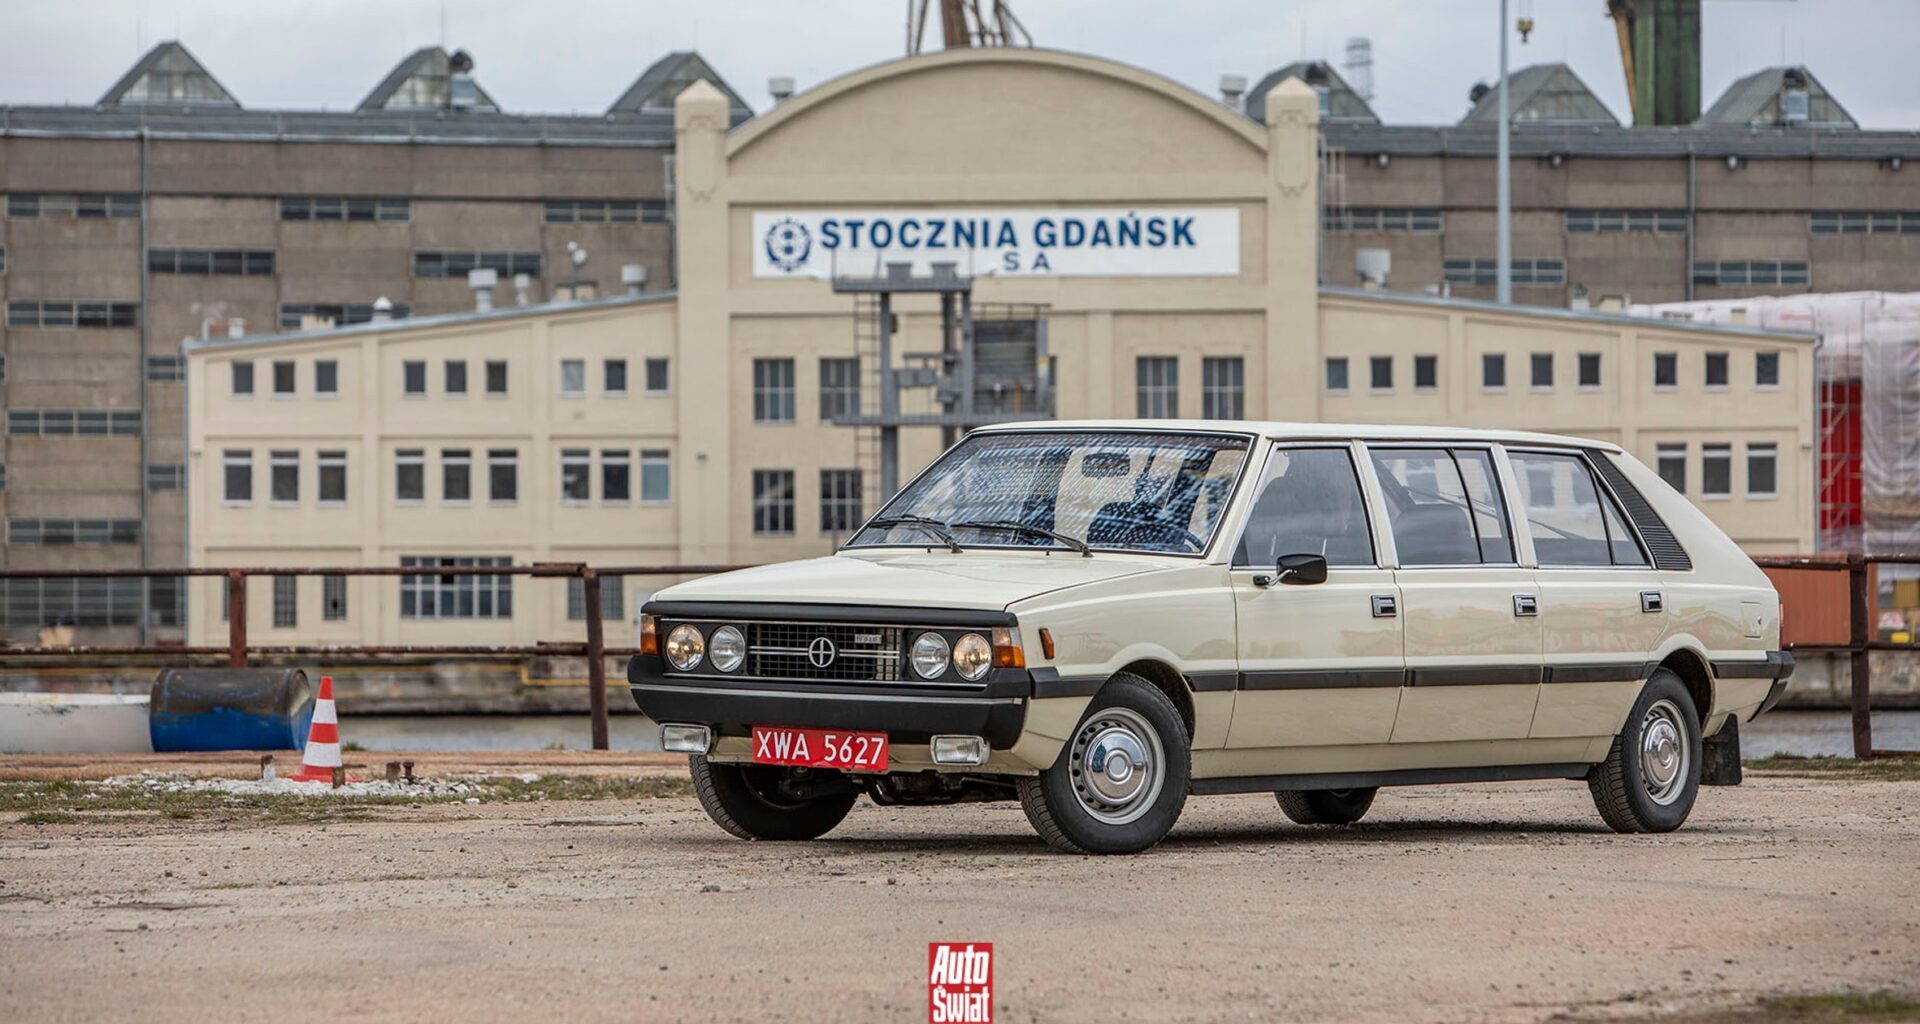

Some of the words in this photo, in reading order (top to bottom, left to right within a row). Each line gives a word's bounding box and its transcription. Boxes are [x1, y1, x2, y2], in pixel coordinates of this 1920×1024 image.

[821, 219, 1018, 248] STOCZNIA
[1034, 211, 1196, 247] GDAŃSK
[756, 730, 810, 761] XWA
[824, 734, 884, 765] 5627
